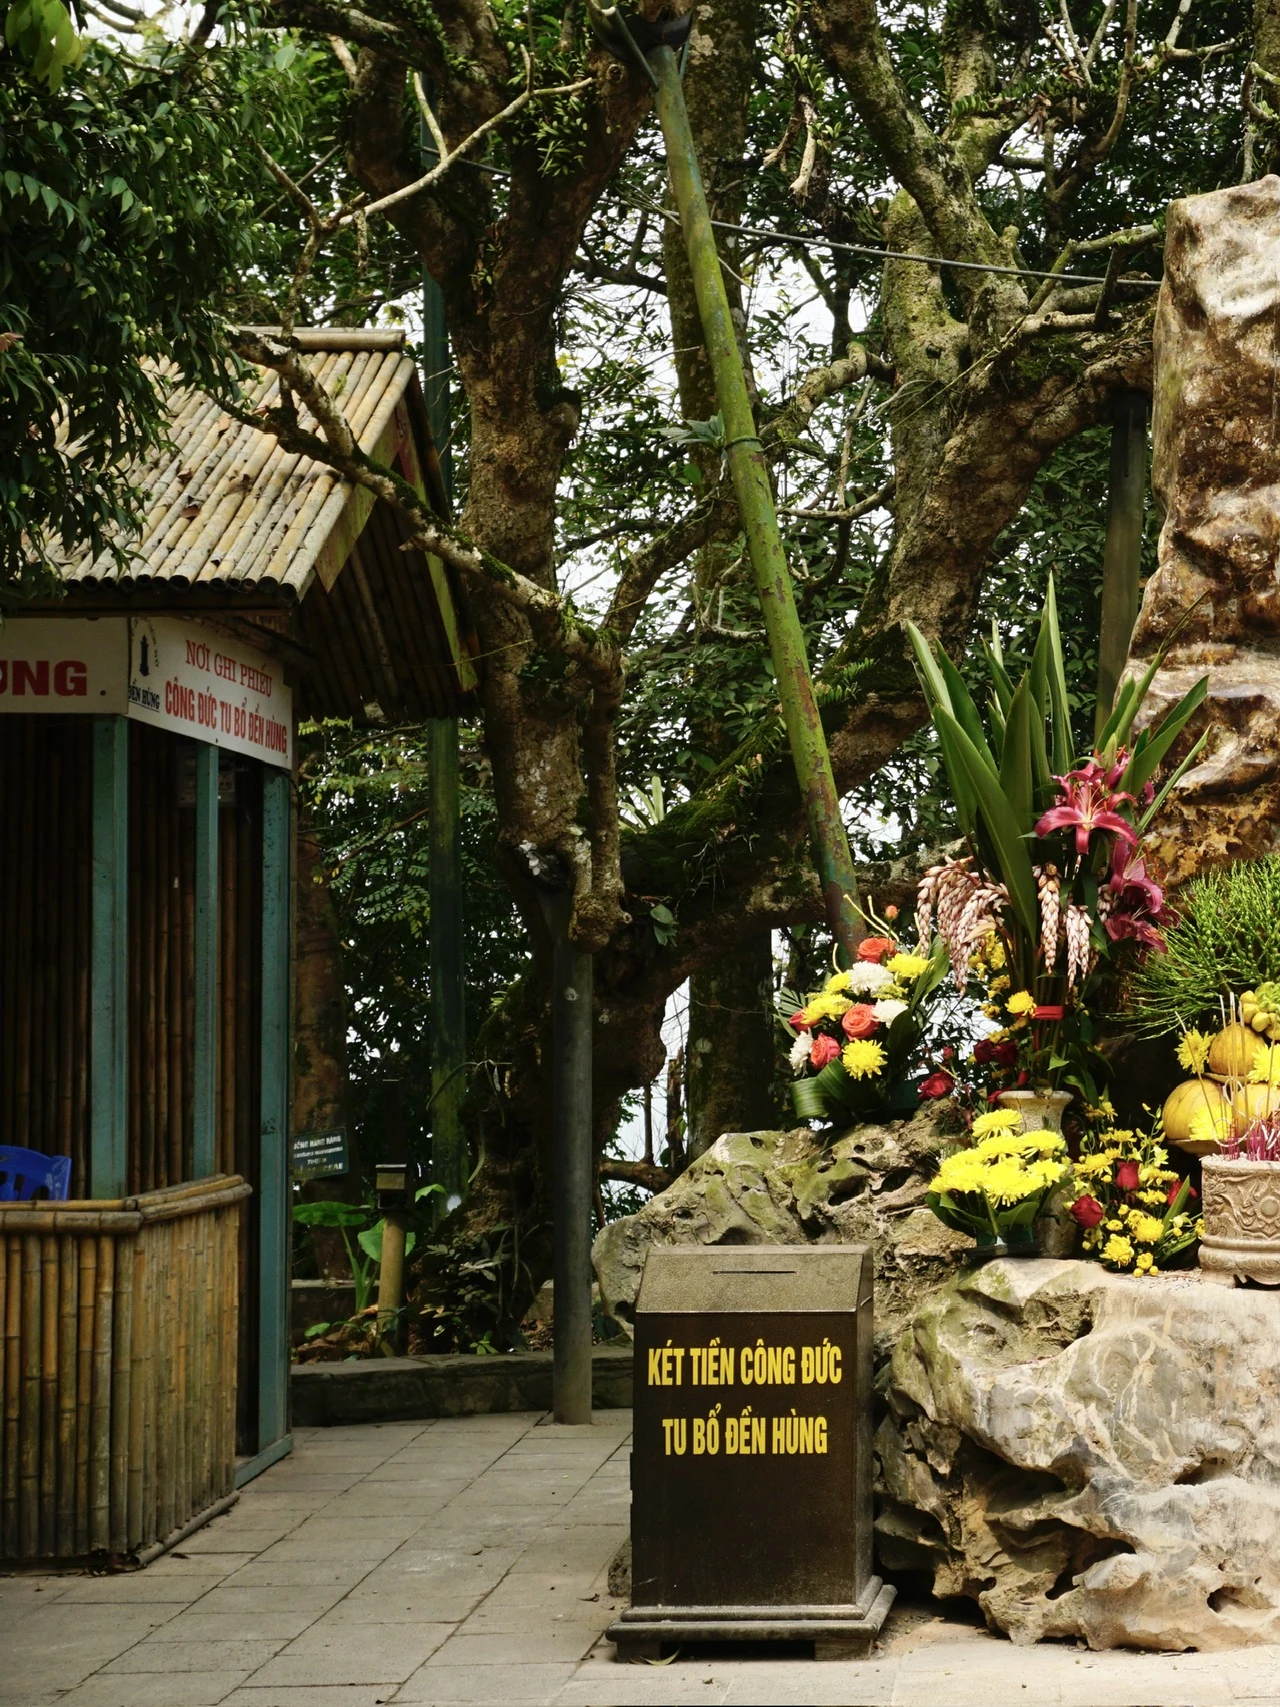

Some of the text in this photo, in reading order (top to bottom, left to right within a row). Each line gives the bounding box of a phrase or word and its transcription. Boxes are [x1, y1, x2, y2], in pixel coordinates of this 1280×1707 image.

[185, 639, 211, 673] NƠI
[214, 652, 237, 683] GHI
[240, 662, 273, 698] PHIẾU
[165, 677, 287, 753] CÔNG ĐỨC TU BỔ ĐỀN HÙNG
[648, 1337, 842, 1386] KÉT TIỀN CÔNG ĐỨC
[662, 1402, 828, 1456] TU BỔ ĐỀN HÙNG
